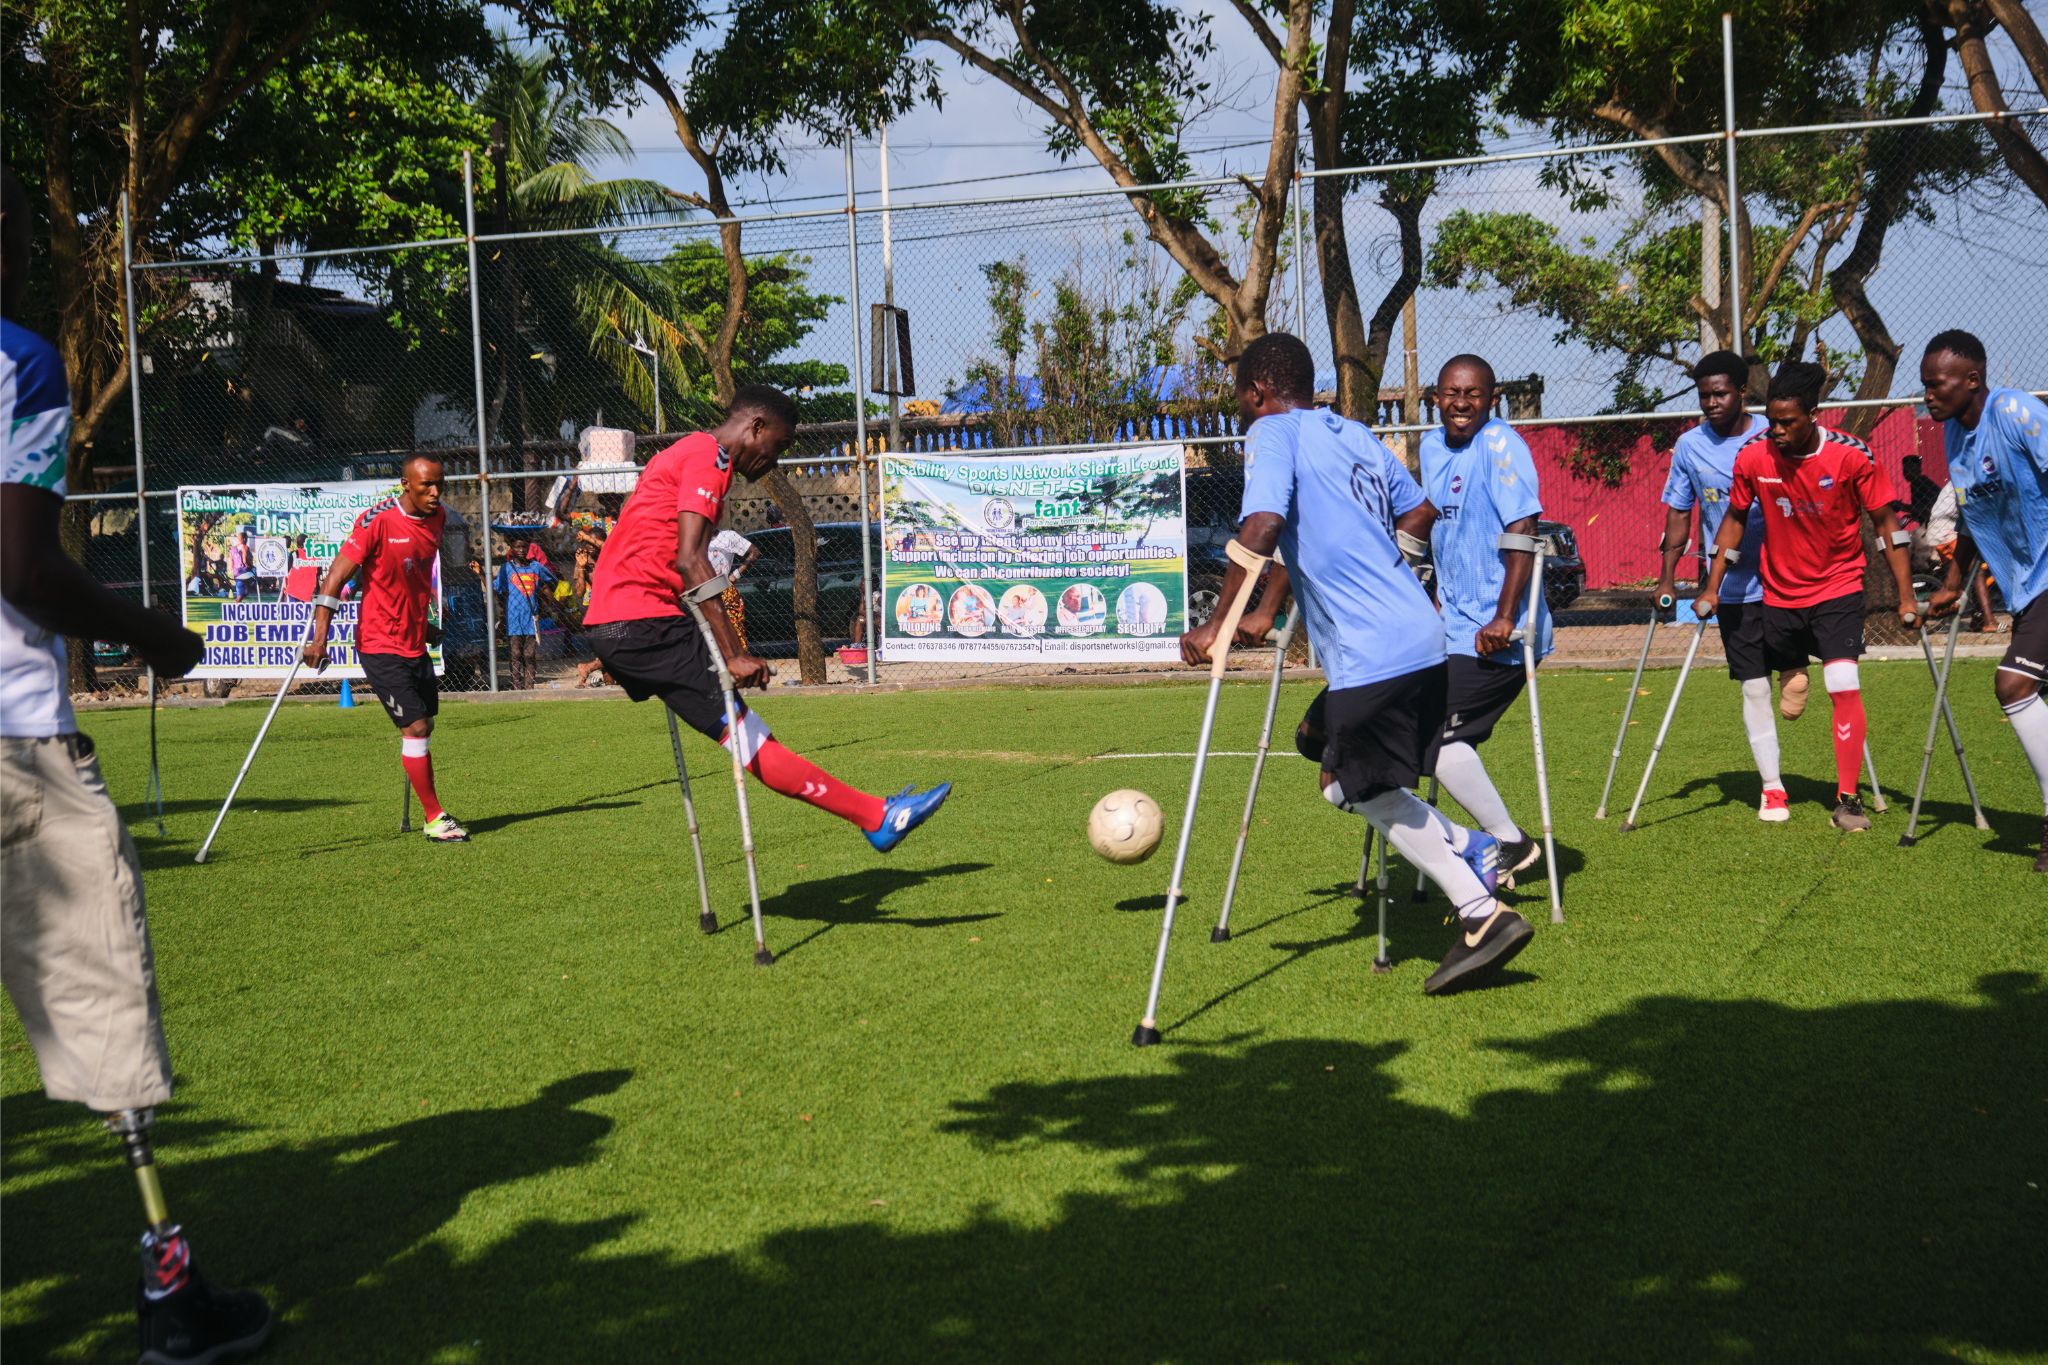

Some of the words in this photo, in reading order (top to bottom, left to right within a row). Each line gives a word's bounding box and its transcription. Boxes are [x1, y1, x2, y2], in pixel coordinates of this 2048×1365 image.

[884, 460, 954, 481] Disability
[958, 464, 1008, 482] Sports
[1012, 463, 1076, 480] Network
[1079, 460, 1127, 477] Sierra
[1131, 457, 1179, 473] Leone
[969, 478, 1102, 497] DIsNET-SL
[183, 496, 243, 512] Disability
[246, 496, 288, 511] Sports
[292, 493, 346, 509] Network
[1034, 496, 1081, 518] fant
[256, 511, 356, 535] DIsNET-S
[935, 534, 959, 547] See
[960, 535, 980, 549] my
[1021, 535, 1042, 548] not
[1044, 536, 1063, 548] my
[1064, 532, 1128, 546] disability.
[891, 549, 938, 563] Support
[998, 550, 1013, 564] by
[1014, 550, 1064, 564] offering
[1065, 549, 1086, 563] job
[1088, 546, 1176, 561] opportunities.
[934, 564, 954, 578] We
[955, 567, 978, 579] can
[980, 566, 997, 579] all
[998, 566, 1063, 579] contribute
[1064, 566, 1078, 578] to
[1080, 563, 1131, 578] society!
[223, 603, 277, 621] INCLUDE
[206, 624, 249, 642] JOB
[898, 622, 942, 633] TAILORING
[1117, 622, 1167, 634] SECURITY
[885, 641, 916, 651] Contact:
[1044, 641, 1068, 651] Email:
